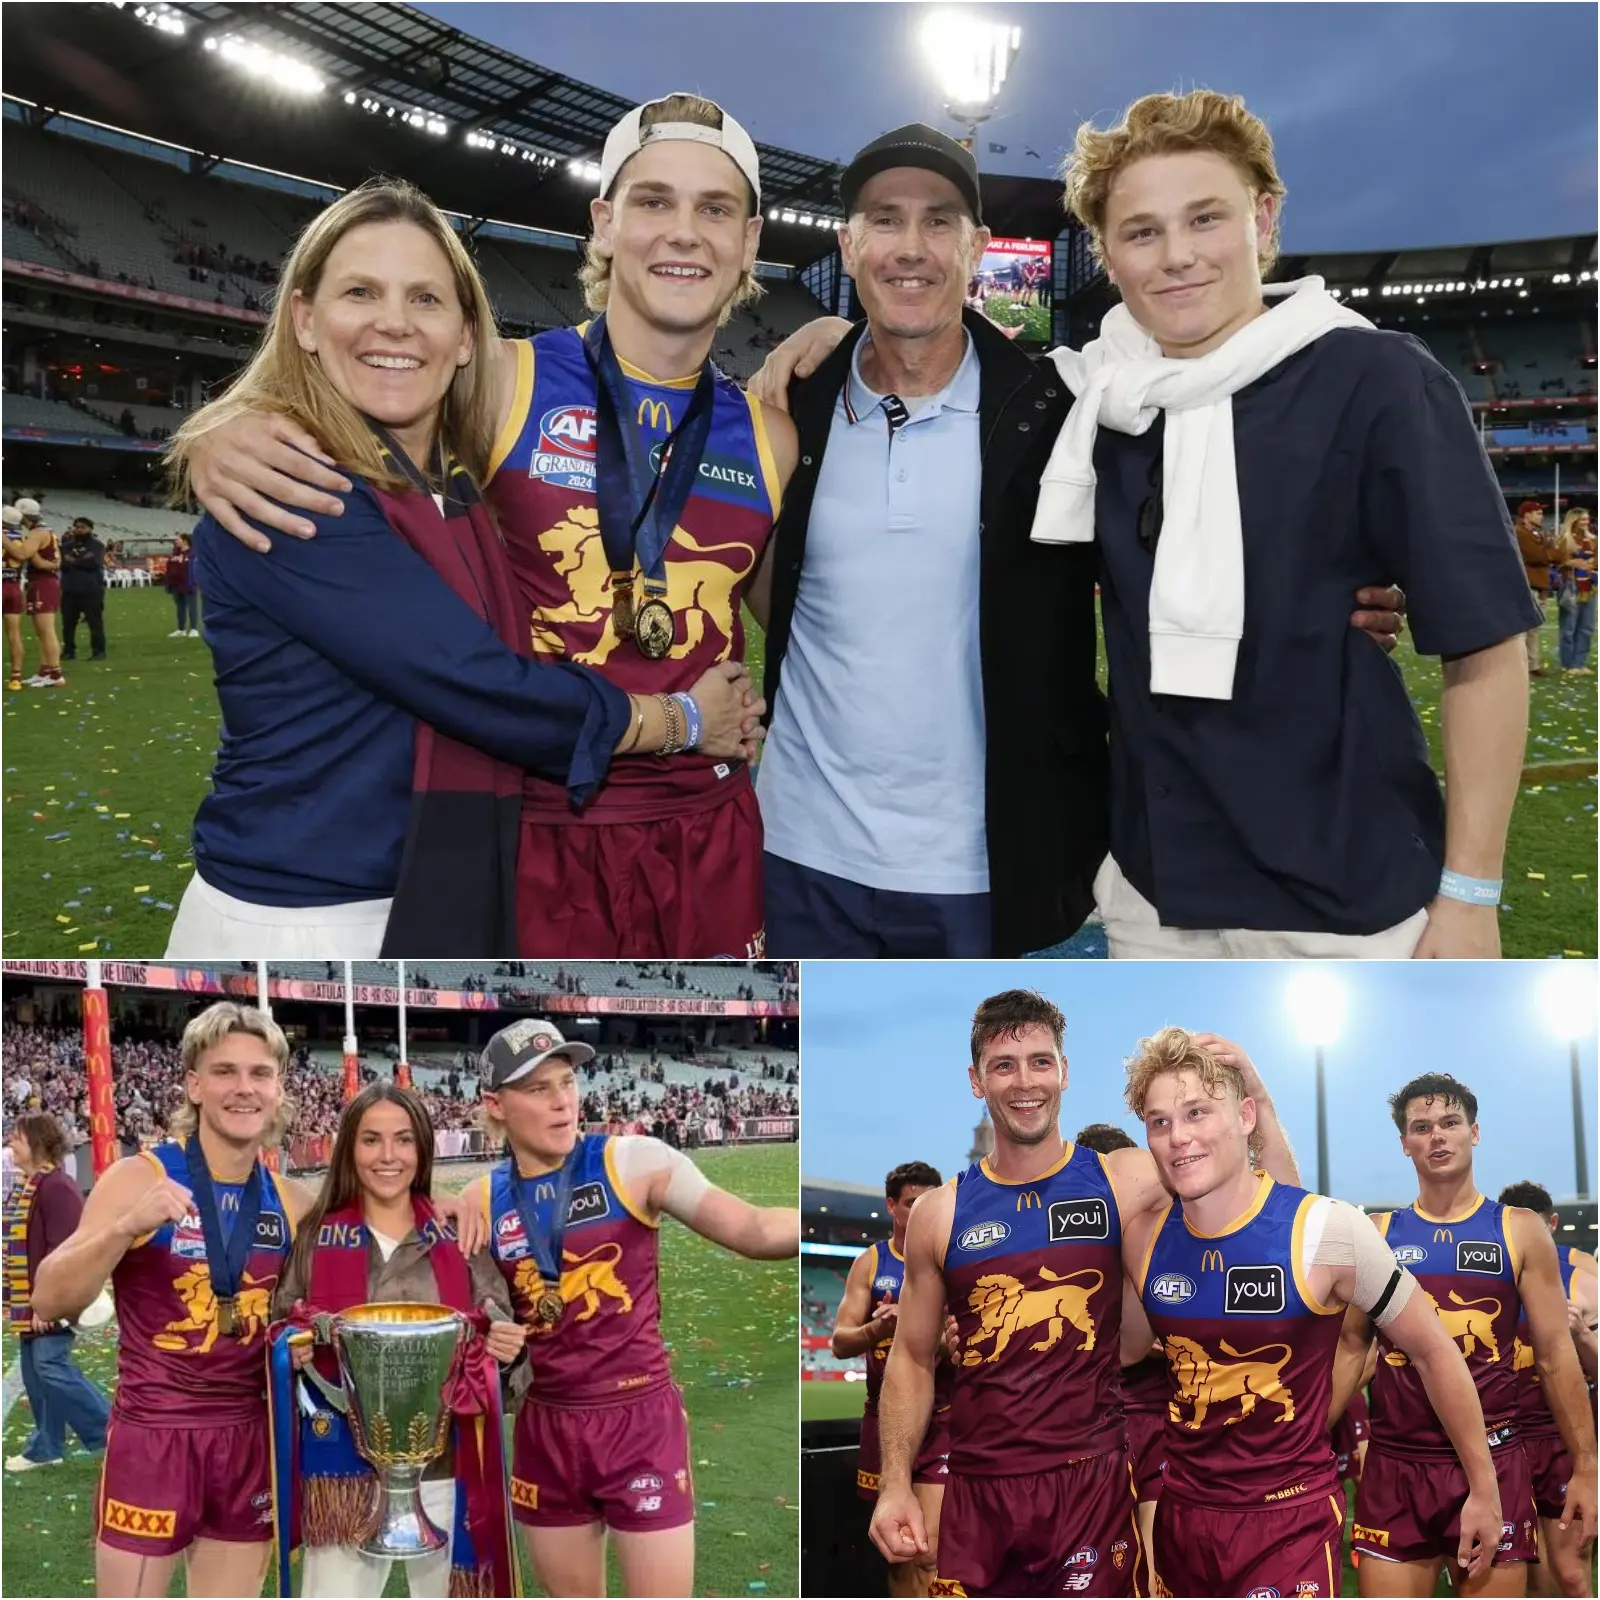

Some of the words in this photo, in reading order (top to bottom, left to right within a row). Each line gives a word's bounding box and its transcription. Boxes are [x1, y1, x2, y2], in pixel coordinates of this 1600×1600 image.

[548, 414, 596, 441] AF
[536, 455, 582, 473] GRAND
[583, 460, 596, 476] FI
[568, 475, 593, 489] 2024
[700, 463, 756, 489] CALTEX
[180, 1215, 201, 1229] AF
[257, 1219, 280, 1237] oui
[500, 1216, 521, 1235] AF
[1058, 1205, 1102, 1233] youi
[318, 1222, 361, 1248] ONS
[962, 1227, 1006, 1247] AFL
[1394, 1249, 1424, 1261] AFL
[1463, 1248, 1497, 1266] youi
[875, 1279, 897, 1288] AFL
[1153, 1280, 1192, 1297] AFL
[1233, 1274, 1276, 1304] youi
[631, 1479, 661, 1490] AFL
[859, 1472, 880, 1489] XXX
[109, 1503, 171, 1534] XXXX
[1502, 1525, 1514, 1535] FL
[1111, 1541, 1128, 1553] LIONS
[1064, 1552, 1094, 1567] AFL
